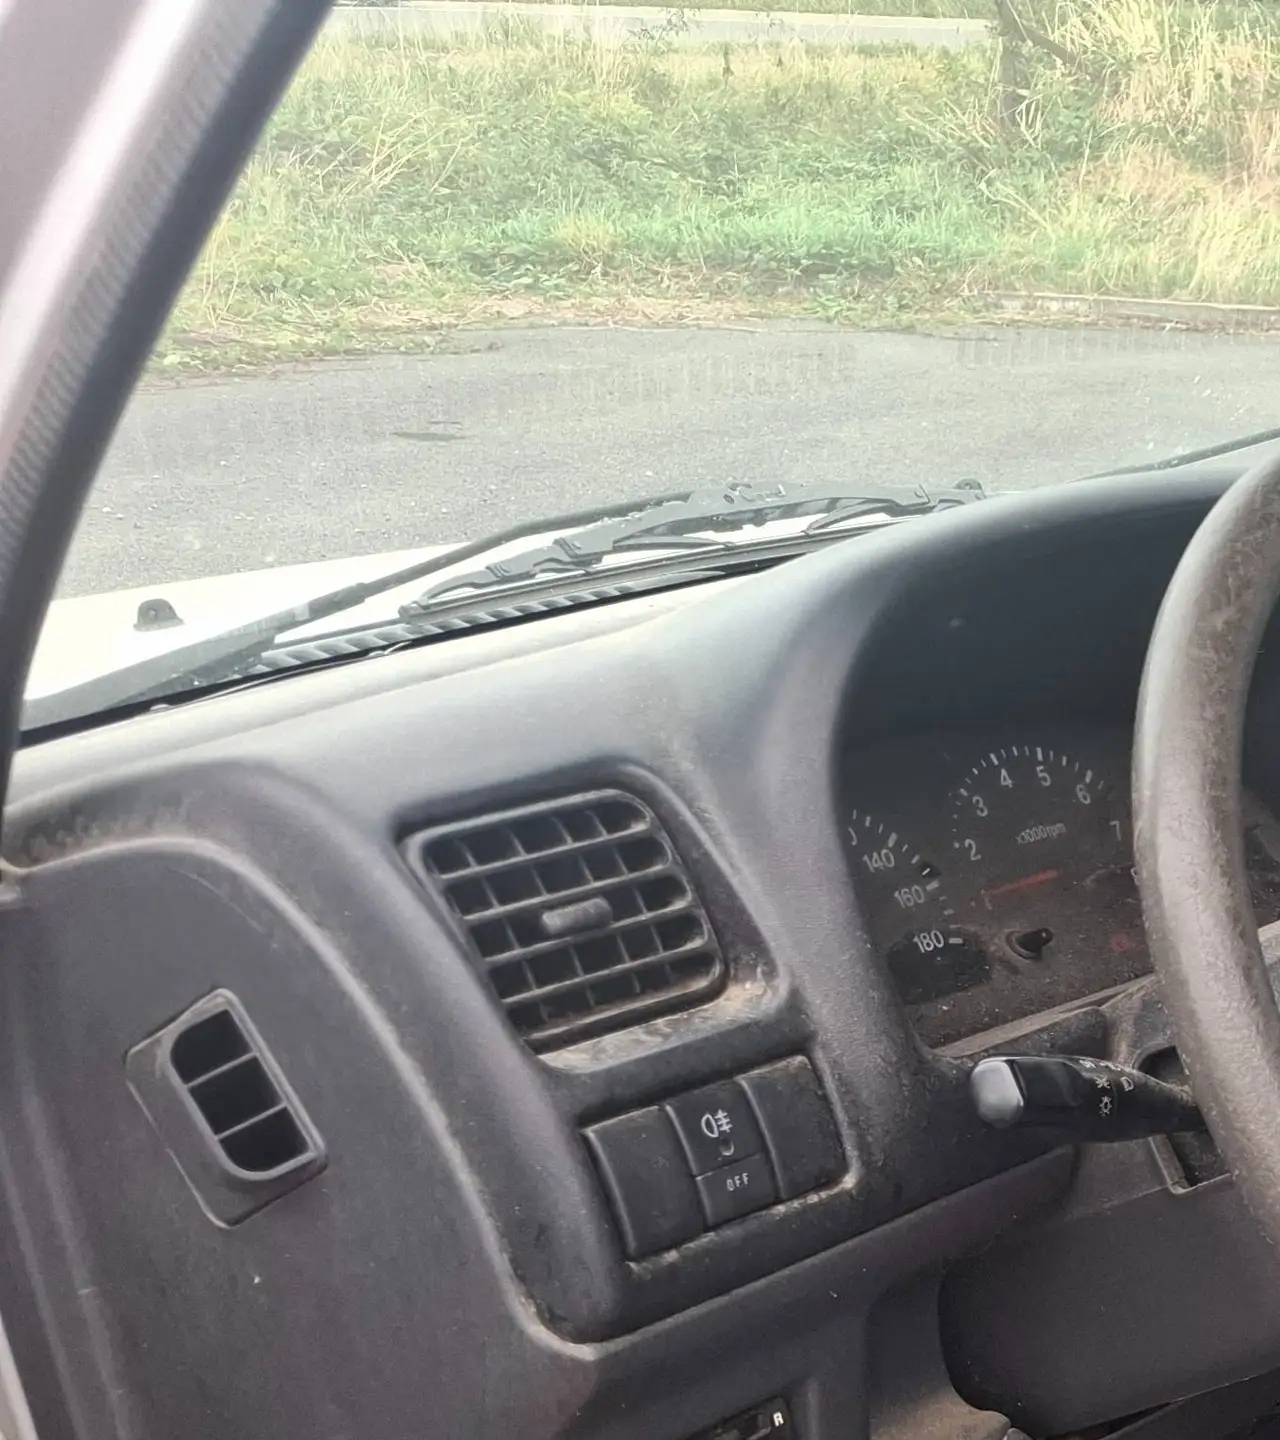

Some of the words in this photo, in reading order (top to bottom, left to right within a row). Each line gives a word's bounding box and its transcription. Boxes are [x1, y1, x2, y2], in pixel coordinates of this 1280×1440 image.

[1000, 768, 1013, 788] 4
[1036, 765, 1051, 787] 5
[1075, 784, 1091, 805] 6
[972, 795, 988, 817] 3
[1109, 820, 1122, 841] 7
[964, 838, 982, 861] 2
[862, 849, 895, 873] 140
[893, 885, 924, 908] 160
[913, 930, 945, 953] 180
[726, 1172, 749, 1191] OFF
[773, 1411, 784, 1427] R
